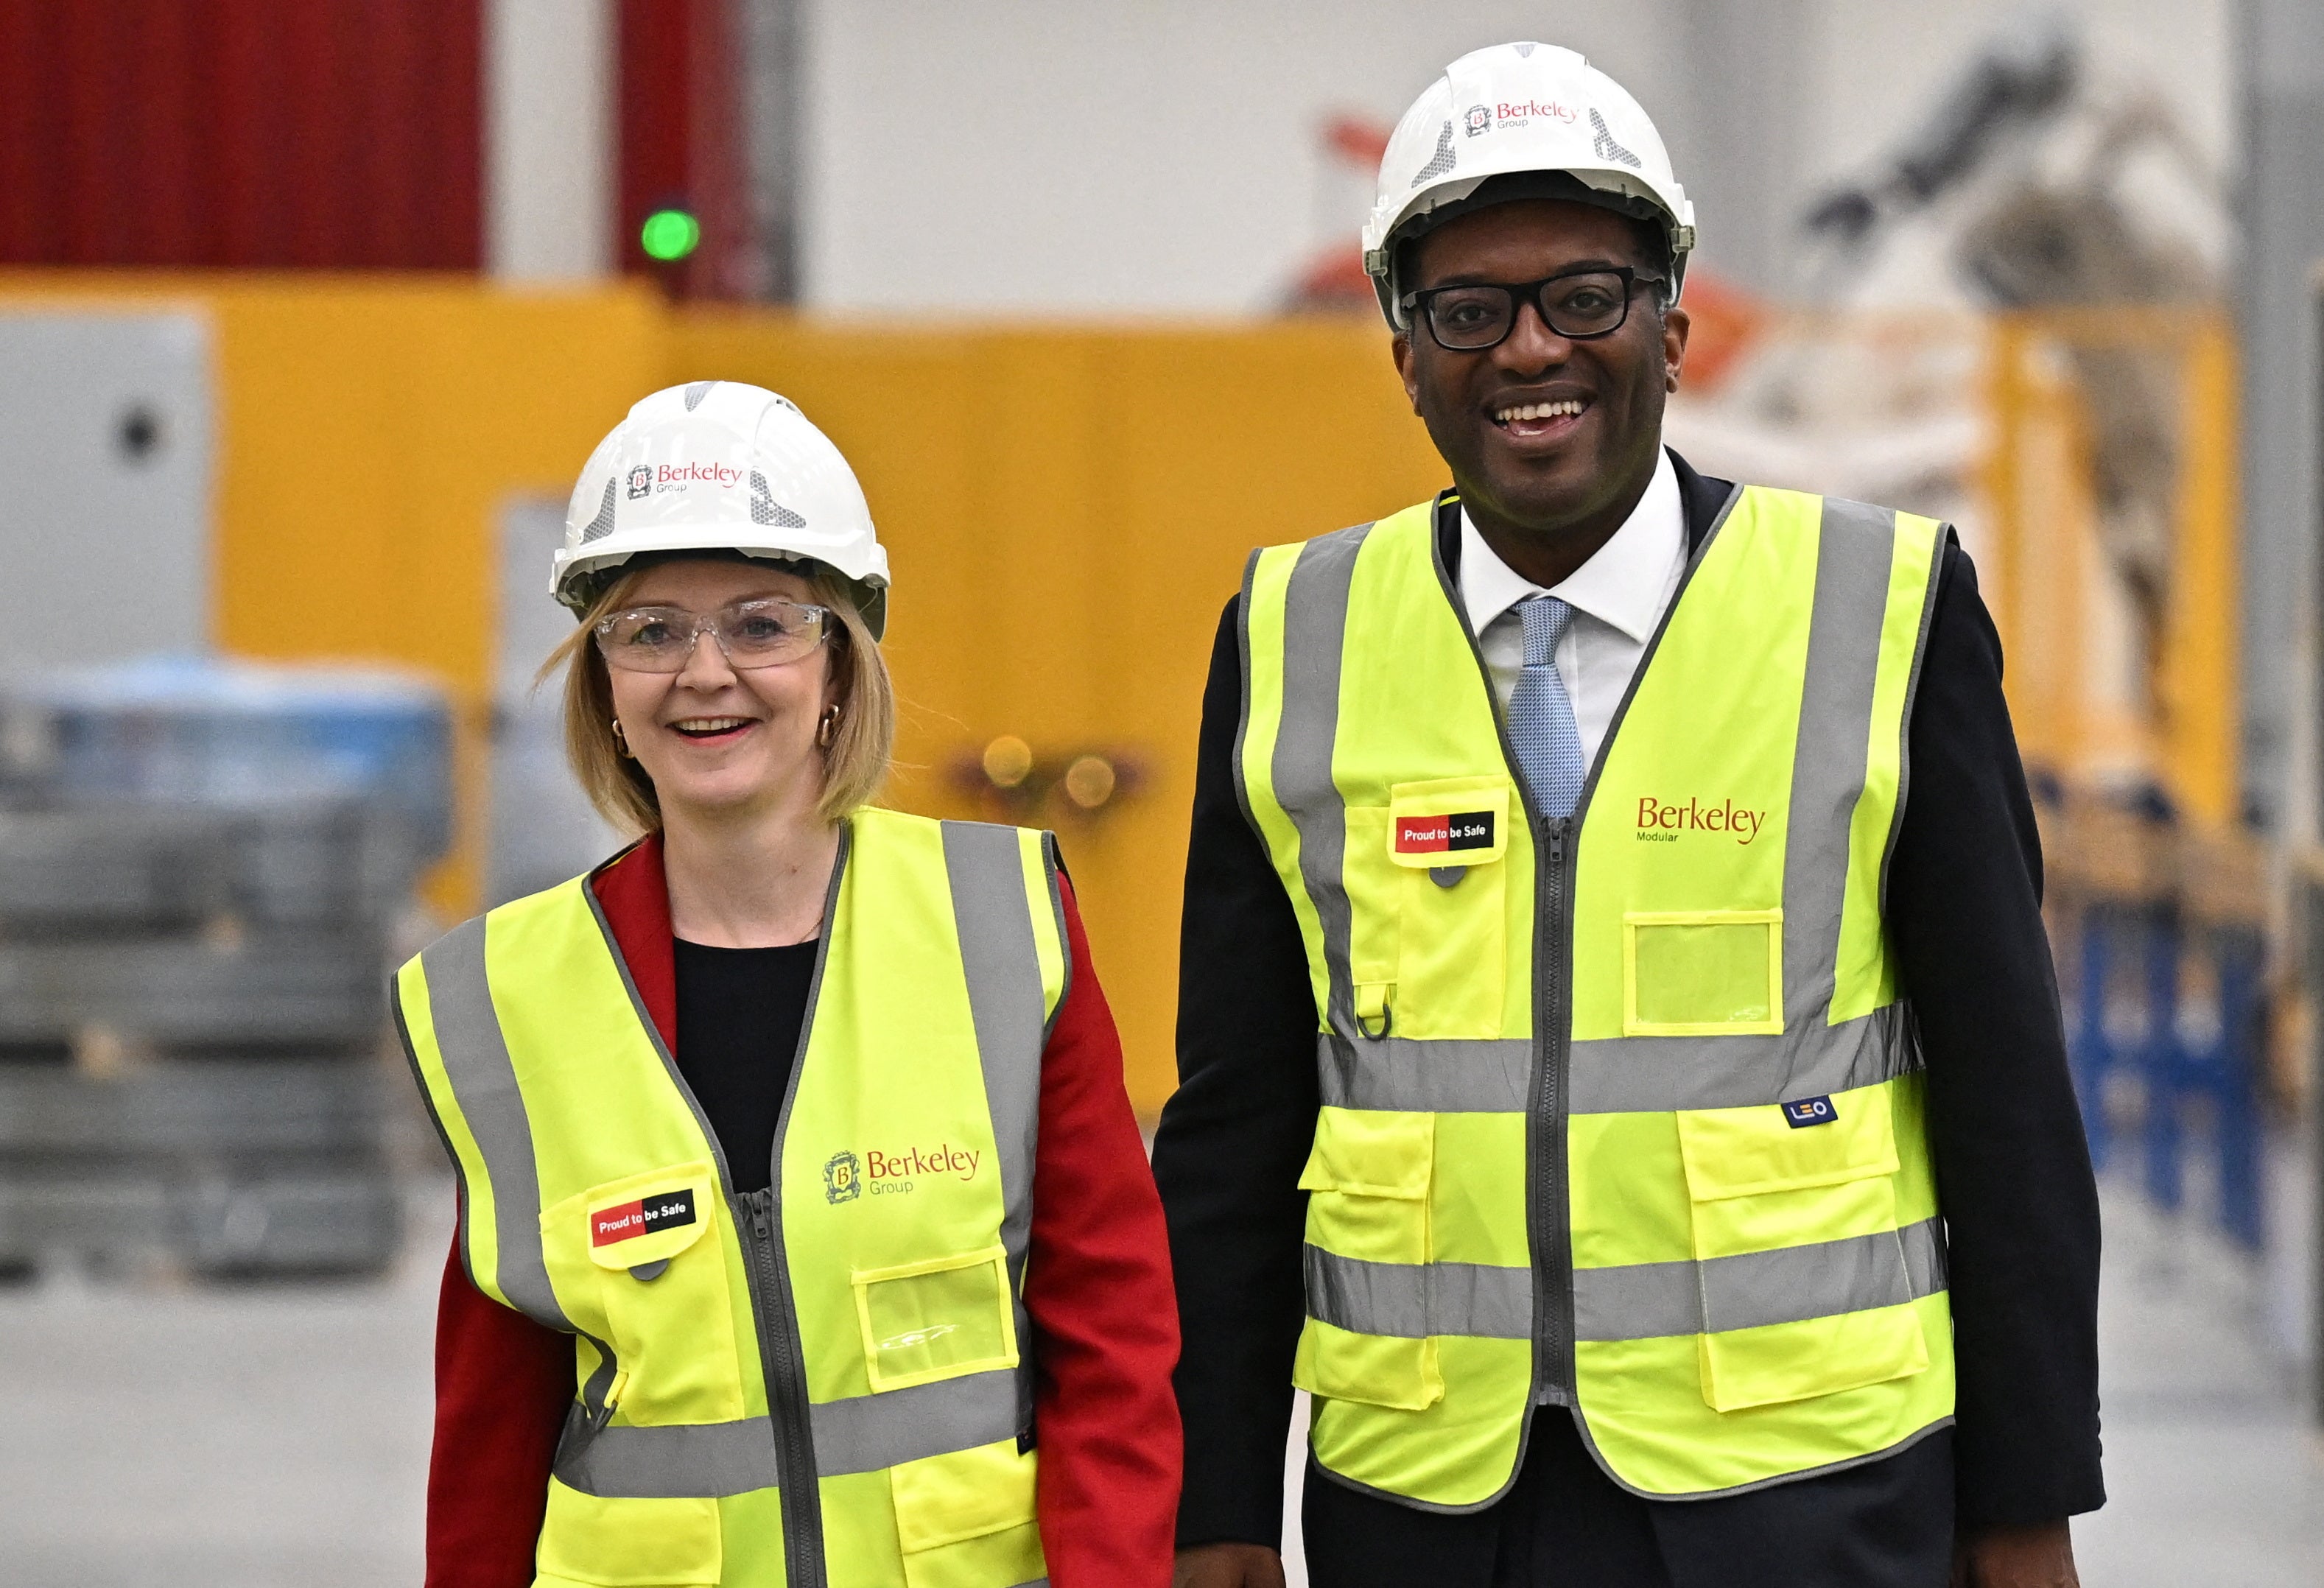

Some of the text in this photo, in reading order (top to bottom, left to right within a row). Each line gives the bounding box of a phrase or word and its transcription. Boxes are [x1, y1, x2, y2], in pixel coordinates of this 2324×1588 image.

[1474, 113, 1483, 124] B
[1498, 100, 1579, 124] Berkeley
[1498, 119, 1528, 129] Group
[636, 474, 644, 486] B
[658, 462, 743, 488] Berkeley
[656, 484, 687, 493] Group
[1637, 797, 1766, 845] Berkeley
[1405, 824, 1486, 841] Proud to be Safe
[1637, 832, 1679, 842] Modular
[1790, 1101, 1827, 1119] LEO
[867, 1144, 980, 1181] Berkeley
[838, 1167, 849, 1185] B
[870, 1181, 913, 1195] Group
[599, 1203, 686, 1234] Proud to be Safe
